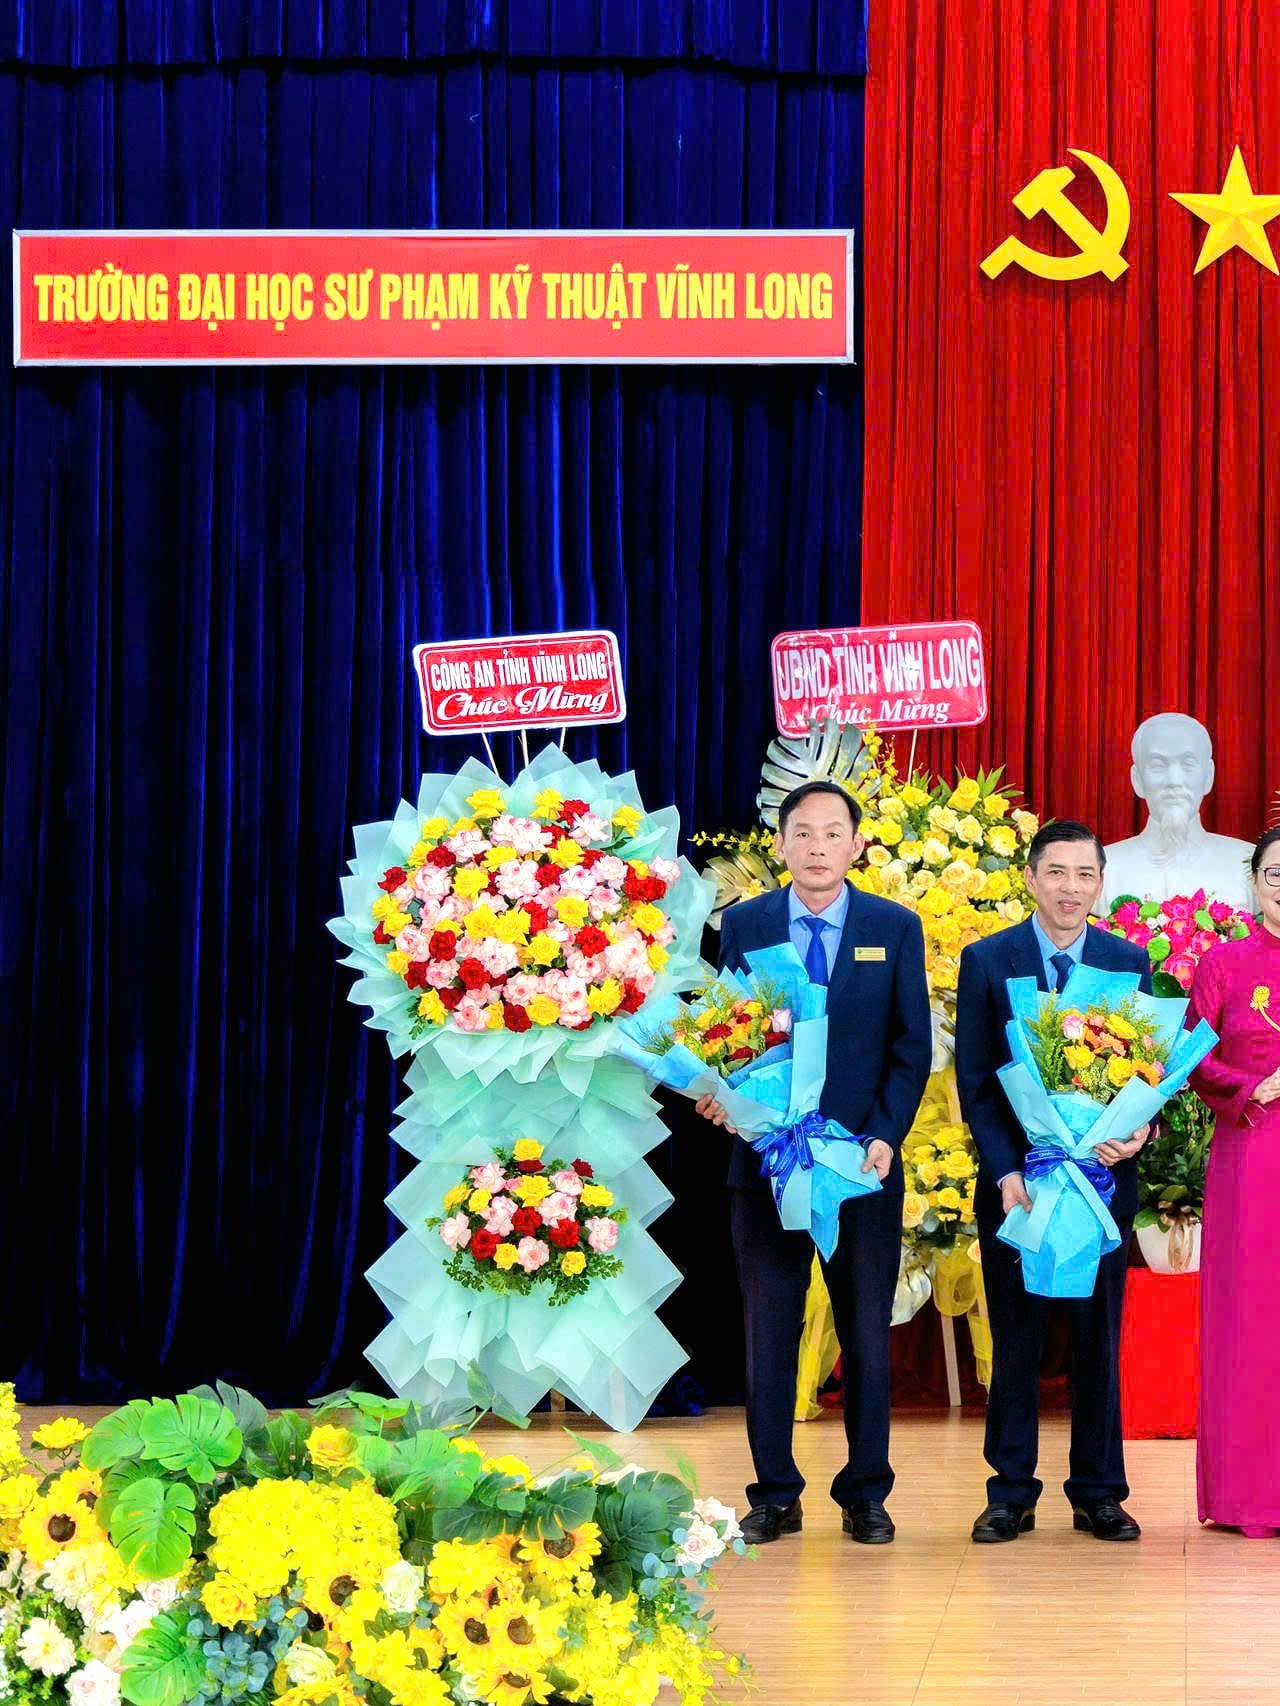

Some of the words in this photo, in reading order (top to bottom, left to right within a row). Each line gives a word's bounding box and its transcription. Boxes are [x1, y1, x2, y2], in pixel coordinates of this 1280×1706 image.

[33, 262, 169, 322] TRƯỜNG
[178, 273, 236, 331] ĐẠI
[246, 273, 314, 331] HỌC
[324, 268, 374, 321] SƯ
[380, 273, 479, 331] PHẠM
[489, 263, 533, 320] KỸ
[542, 262, 647, 330] THUẬT
[655, 263, 736, 320] VĨNH
[745, 273, 833, 320] LONG
[430, 657, 472, 692] CÔNG
[474, 659, 496, 688] AN
[496, 649, 531, 686] TỈNH
[532, 650, 567, 683] VĨNH
[569, 651, 608, 681] LONG
[776, 647, 831, 700] UBND
[832, 633, 877, 695] TỈNH
[879, 630, 925, 693] VĨNH
[928, 637, 981, 689] LONG
[436, 691, 509, 721] Chúc
[514, 685, 609, 714] Mừng
[811, 700, 872, 725] Chúc
[878, 697, 951, 723] Mừng
